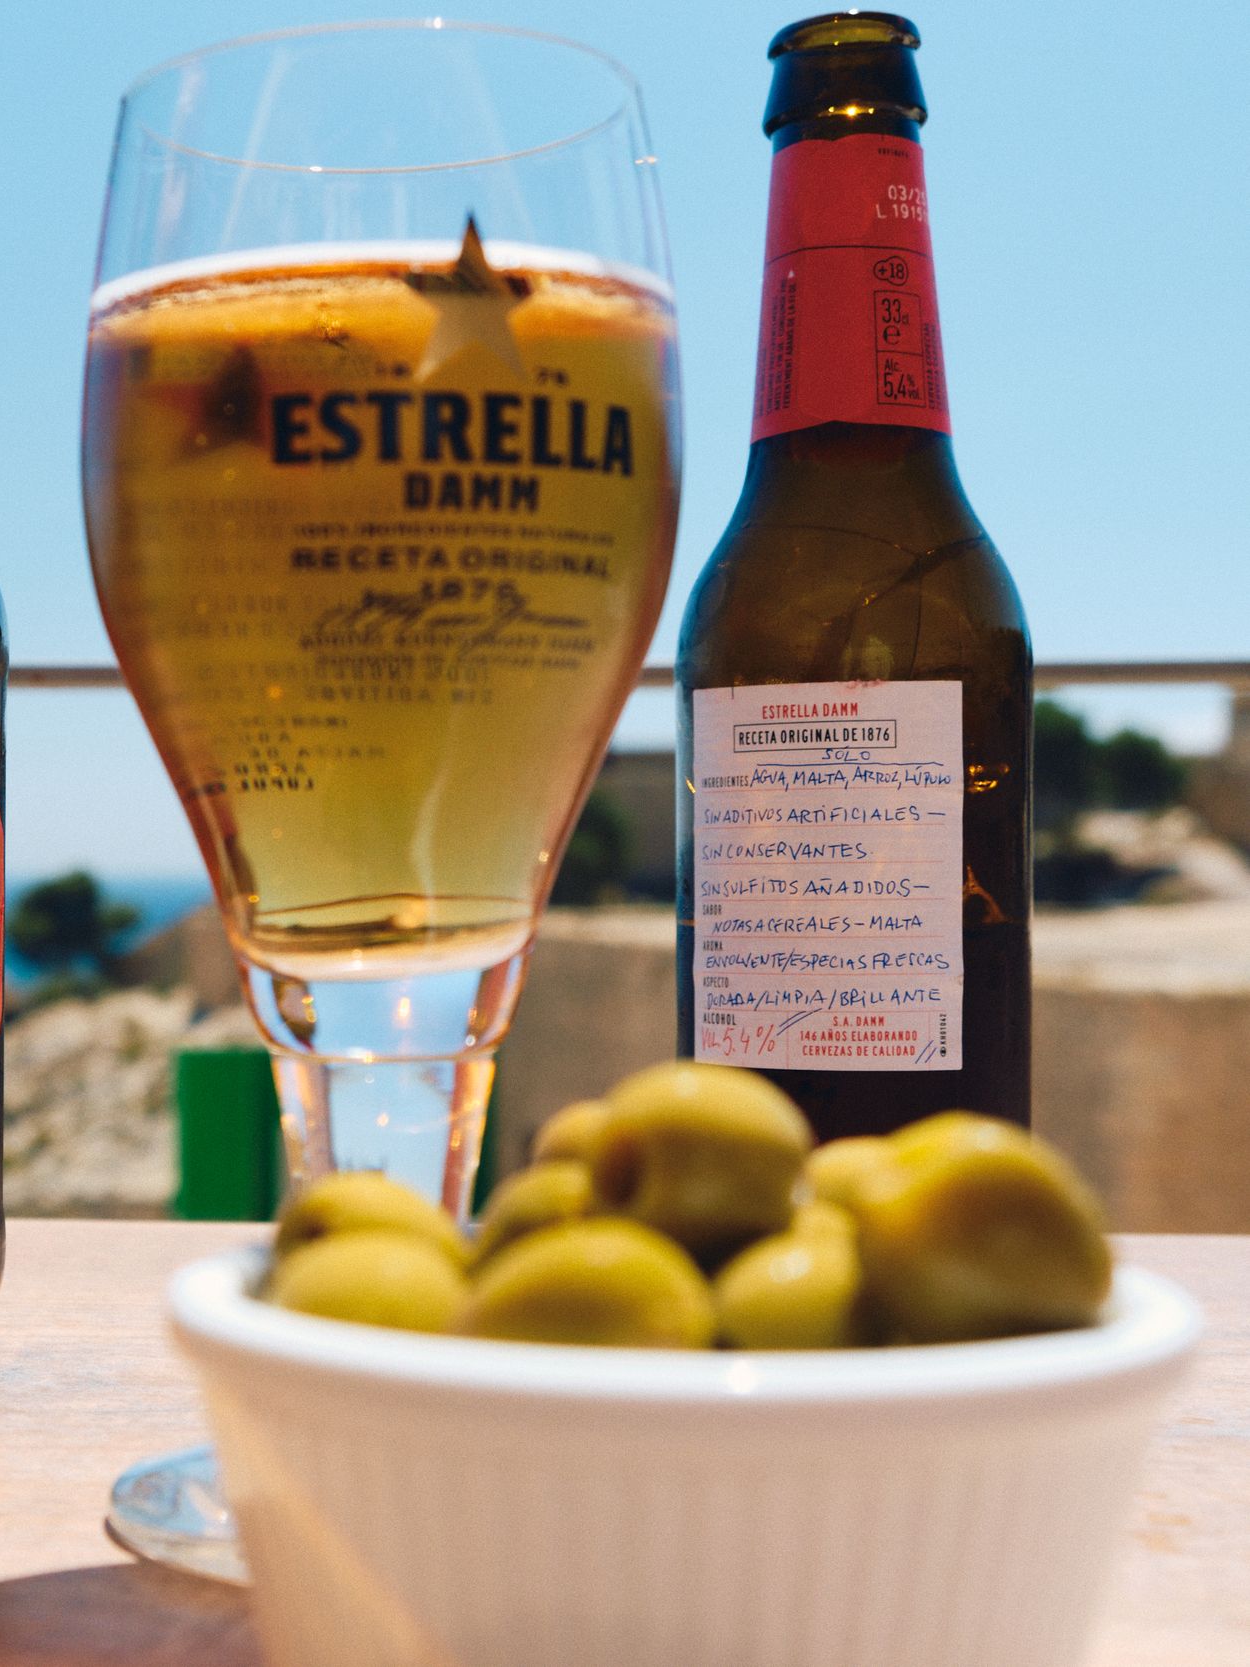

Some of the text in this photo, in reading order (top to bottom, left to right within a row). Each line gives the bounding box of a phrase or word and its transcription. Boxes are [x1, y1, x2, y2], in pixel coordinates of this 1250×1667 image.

[876, 203, 887, 219] L
[878, 263, 904, 280] +18
[881, 298, 901, 324] 33
[883, 372, 907, 401] 5,4
[270, 388, 634, 478] ESTRELLA
[402, 471, 542, 514] DAMM
[290, 546, 611, 580] RECETA ORIGINAL
[762, 702, 859, 720] ESTRELLA DAMM
[738, 727, 890, 745] RECETA ORIGINAL DE 1876
[702, 775, 749, 788] INGREDIENTES
[793, 767, 849, 790] MALTA,
[853, 765, 903, 791] ARROZ,
[905, 765, 952, 786] LÚPULO
[803, 877, 911, 897] AÑADIDOS
[702, 903, 722, 916] SABOR
[768, 915, 852, 933] CEREALES
[870, 914, 923, 932] MALTA
[703, 939, 723, 951] AROMA
[871, 951, 950, 971] FRESCAS
[703, 976, 730, 989] ASPECTO
[703, 1013, 737, 1025] ALCOHOL
[832, 1015, 885, 1027] S.A. DAMM
[799, 1029, 918, 1042] 146 AÑOS ELABORANDO
[801, 1044, 916, 1057] CERVEZAS DE CALIDAD
